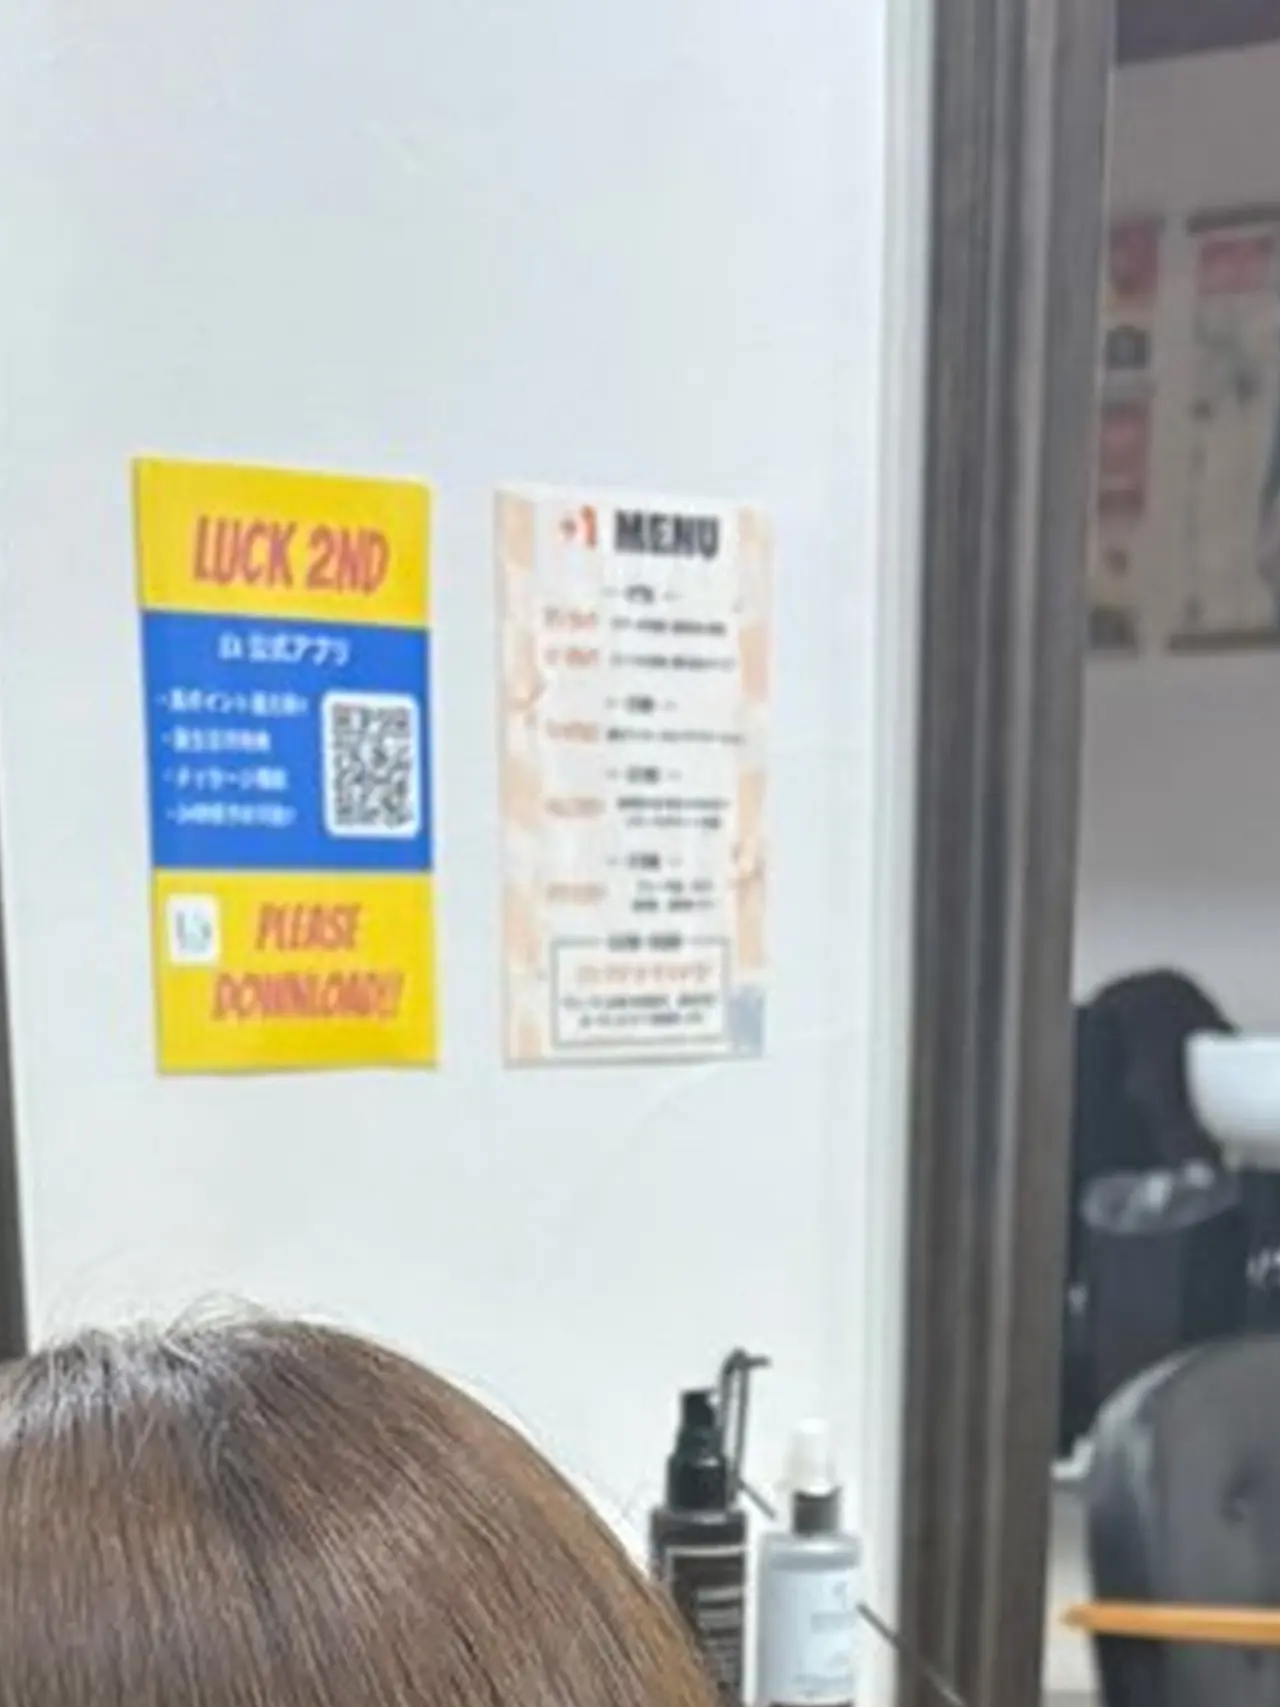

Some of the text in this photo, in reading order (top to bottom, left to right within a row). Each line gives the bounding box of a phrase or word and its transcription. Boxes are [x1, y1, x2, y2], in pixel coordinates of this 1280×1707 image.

[192, 515, 392, 598] LUCK 2ND
[612, 508, 722, 562] MENU
[255, 900, 363, 953] PLEASE
